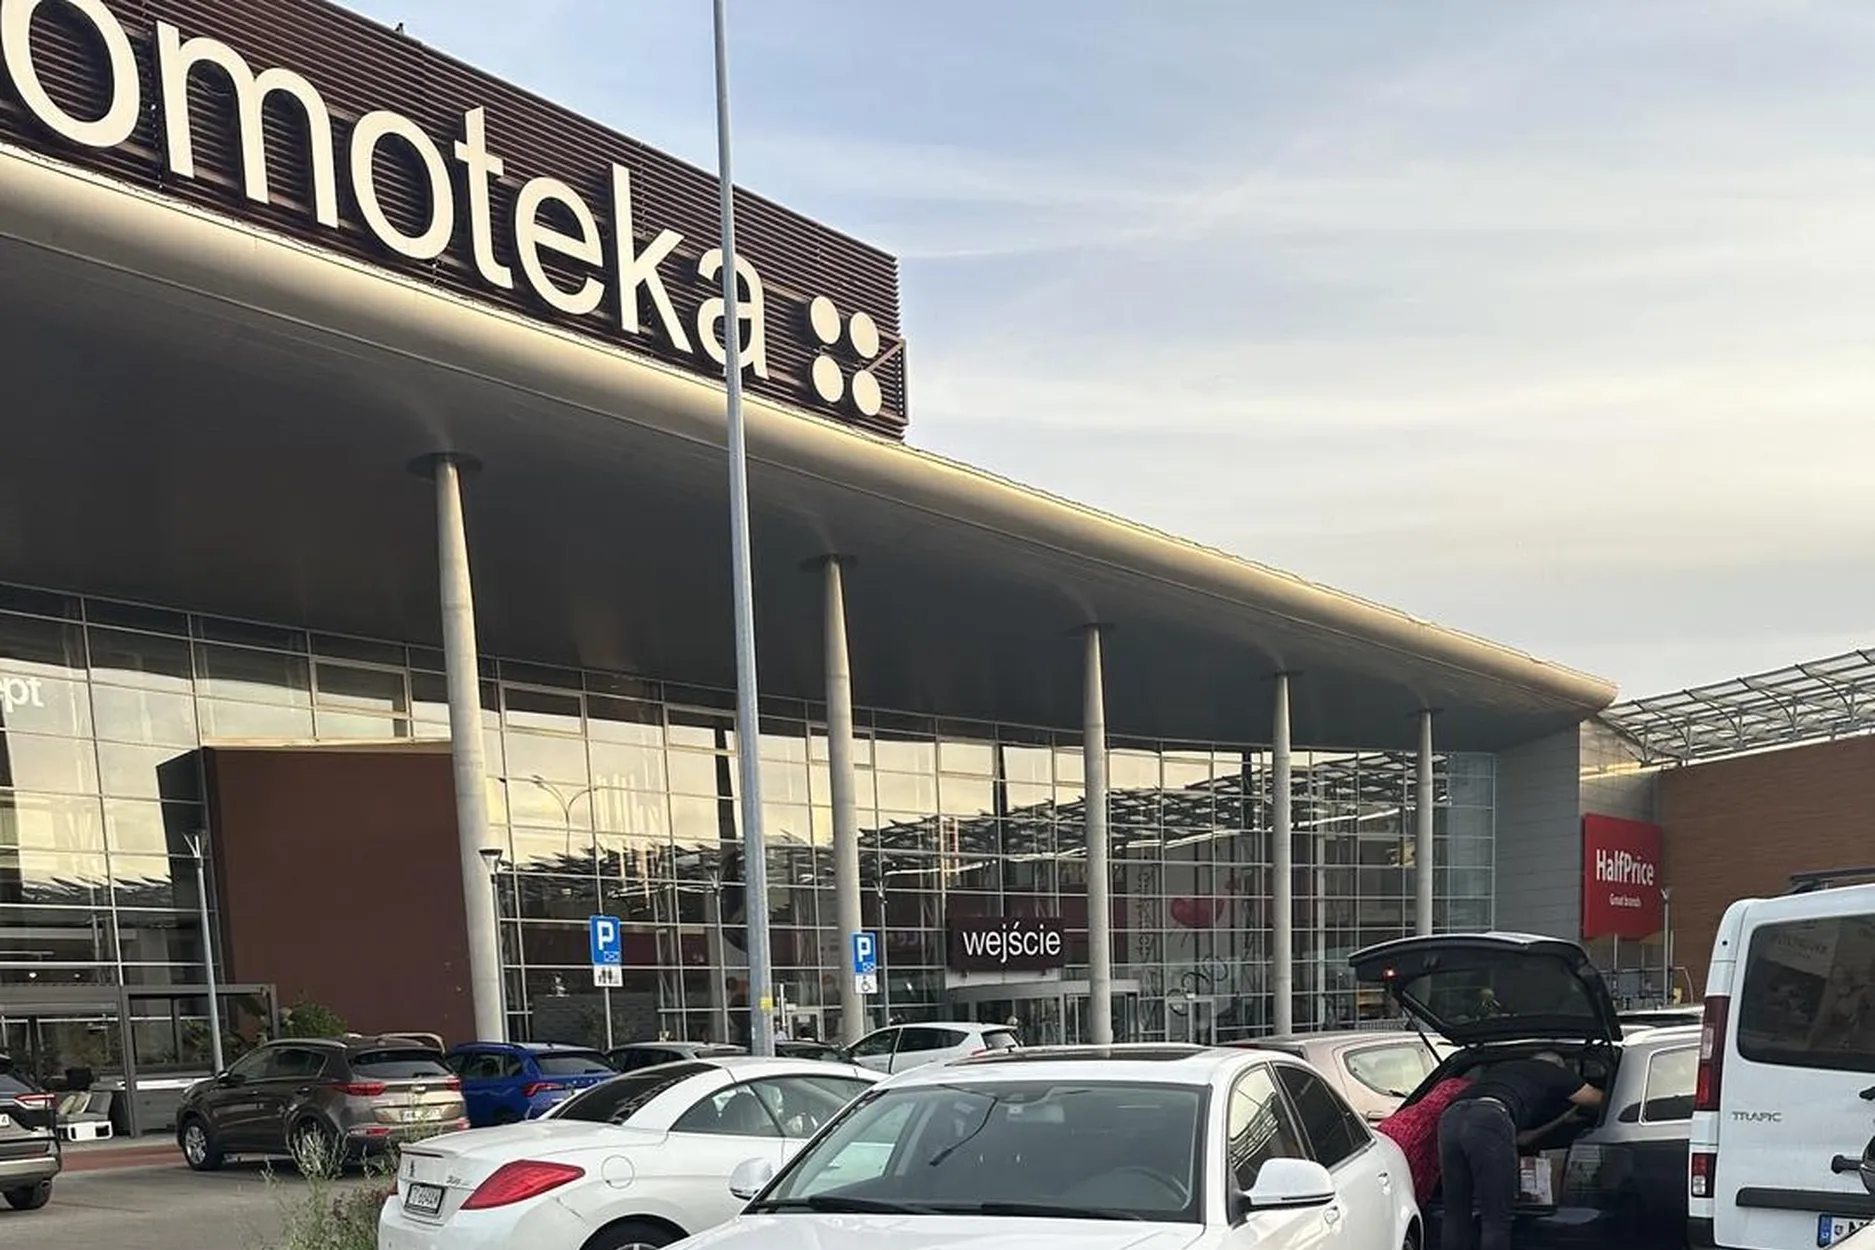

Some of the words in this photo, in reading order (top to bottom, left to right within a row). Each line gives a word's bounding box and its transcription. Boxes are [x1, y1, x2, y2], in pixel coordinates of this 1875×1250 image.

[0, 0, 769, 380] omoteka
[0, 677, 44, 712] pt
[1596, 849, 1654, 886] HalfPrice
[597, 921, 614, 950] P
[857, 937, 871, 962] P
[963, 921, 1060, 963] wejście
